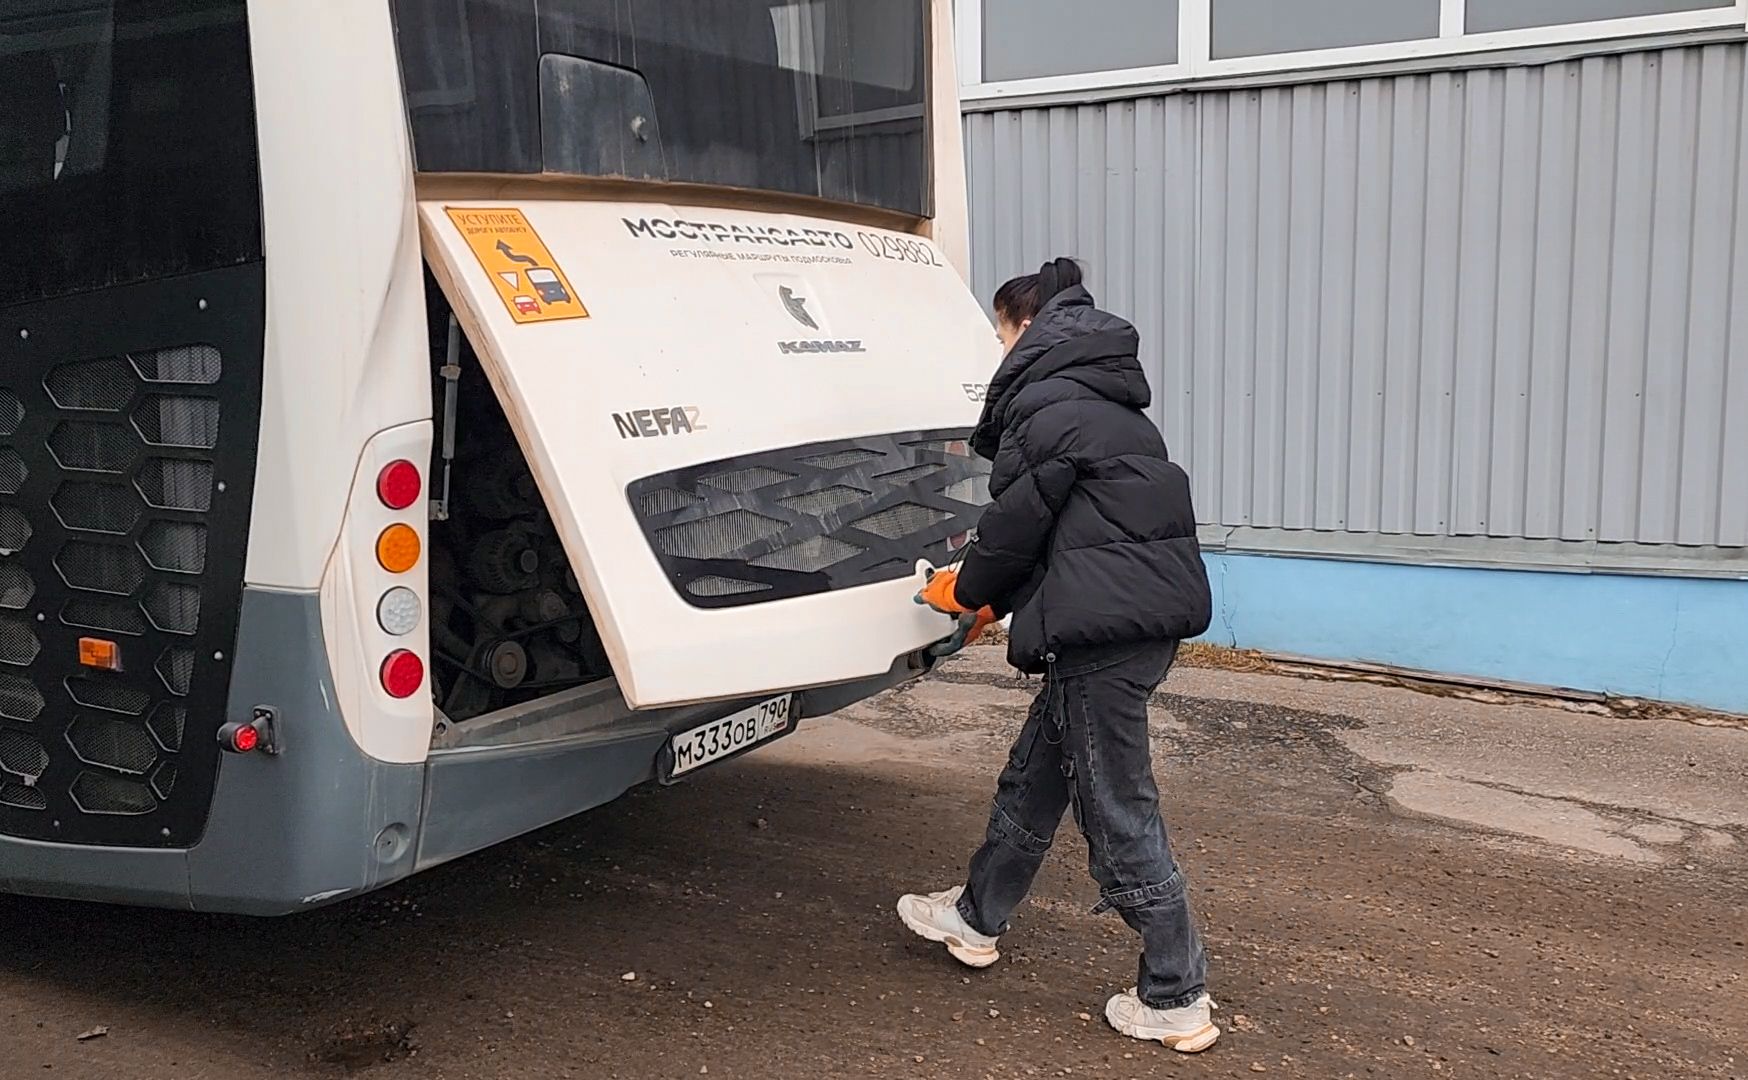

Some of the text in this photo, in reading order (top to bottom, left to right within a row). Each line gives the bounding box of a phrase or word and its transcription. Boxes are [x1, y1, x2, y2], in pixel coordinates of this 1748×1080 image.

[456, 214, 522, 225] УСТУПИТЕ
[621, 217, 853, 250] МОСТРАНСАВТО
[669, 249, 736, 261] РЕГУЛЯРНЫЕ
[736, 253, 790, 263] МАРШРУТЫ
[857, 231, 943, 267] 029882
[778, 340, 866, 354] KAMAZ
[961, 383, 989, 402] 52
[611, 405, 707, 439] NEFAZ
[677, 697, 787, 768] М333ОВ 790
